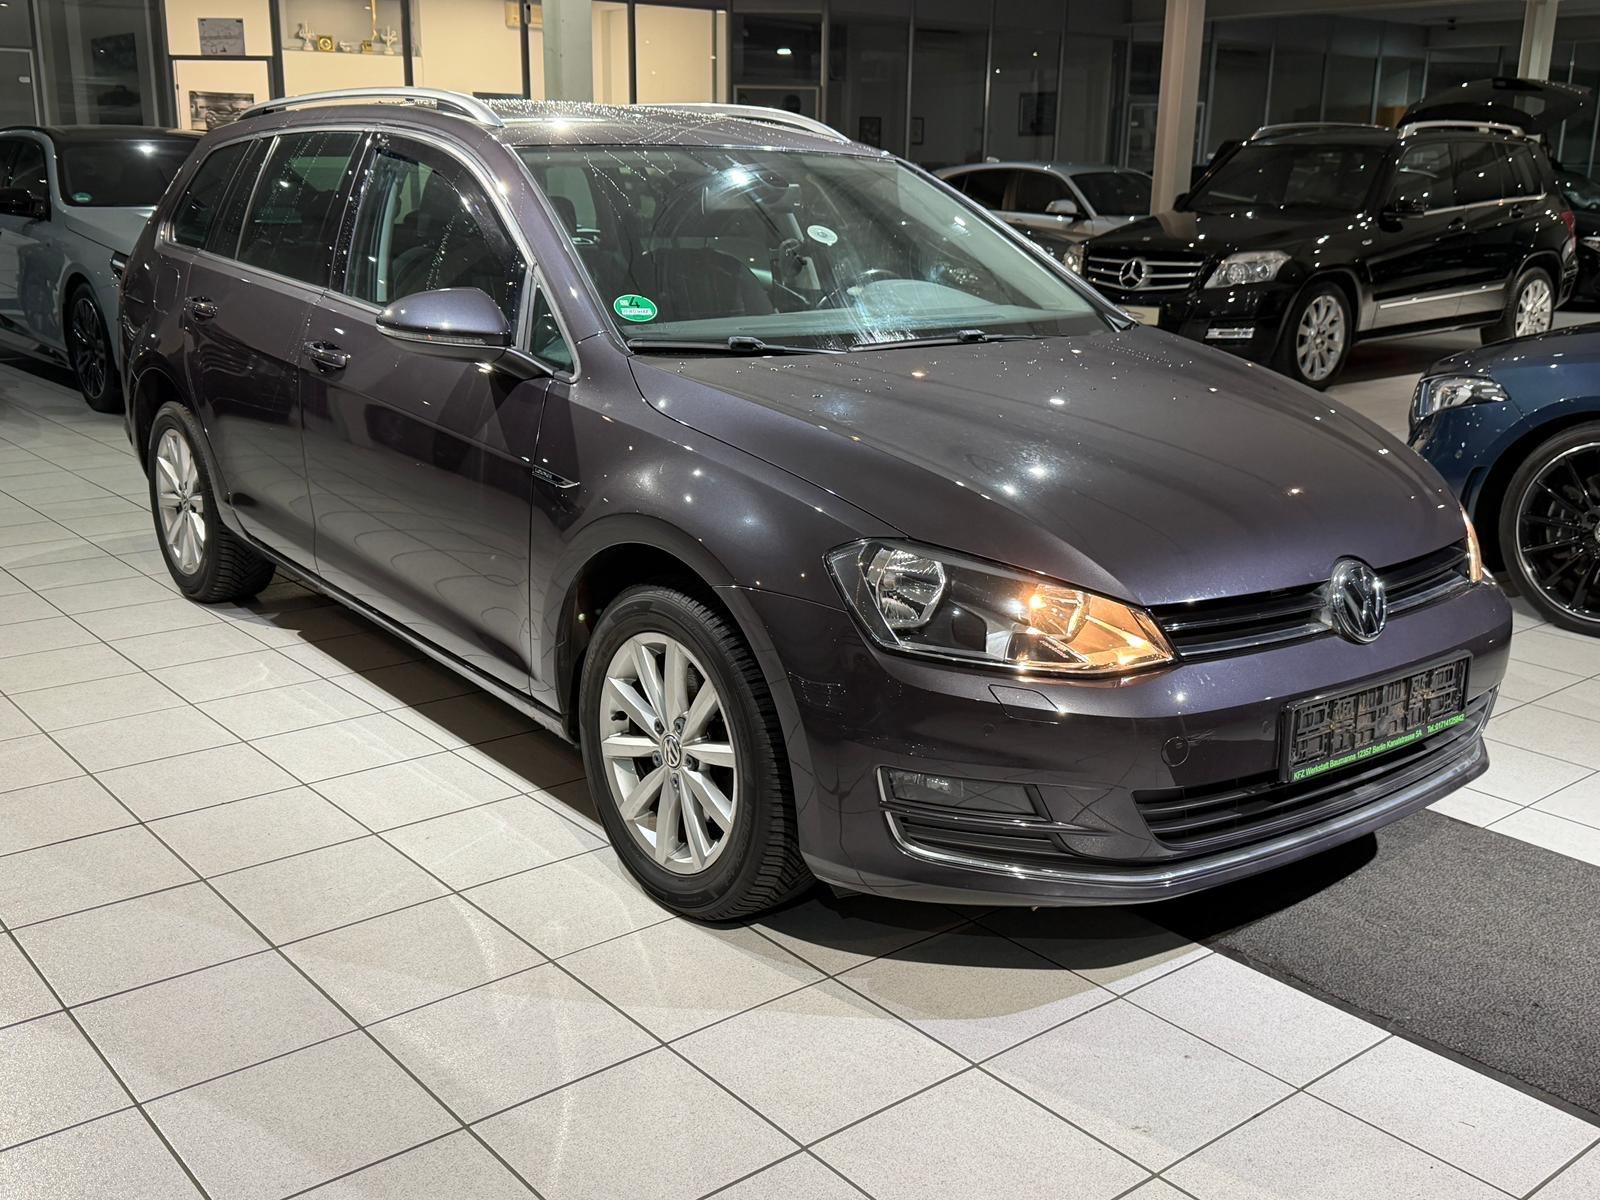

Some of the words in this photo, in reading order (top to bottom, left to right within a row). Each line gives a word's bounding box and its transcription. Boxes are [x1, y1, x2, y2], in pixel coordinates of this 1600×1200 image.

[629, 297, 640, 308] 4
[1293, 769, 1306, 780] KFZ
[1372, 742, 1387, 754] Berlin
